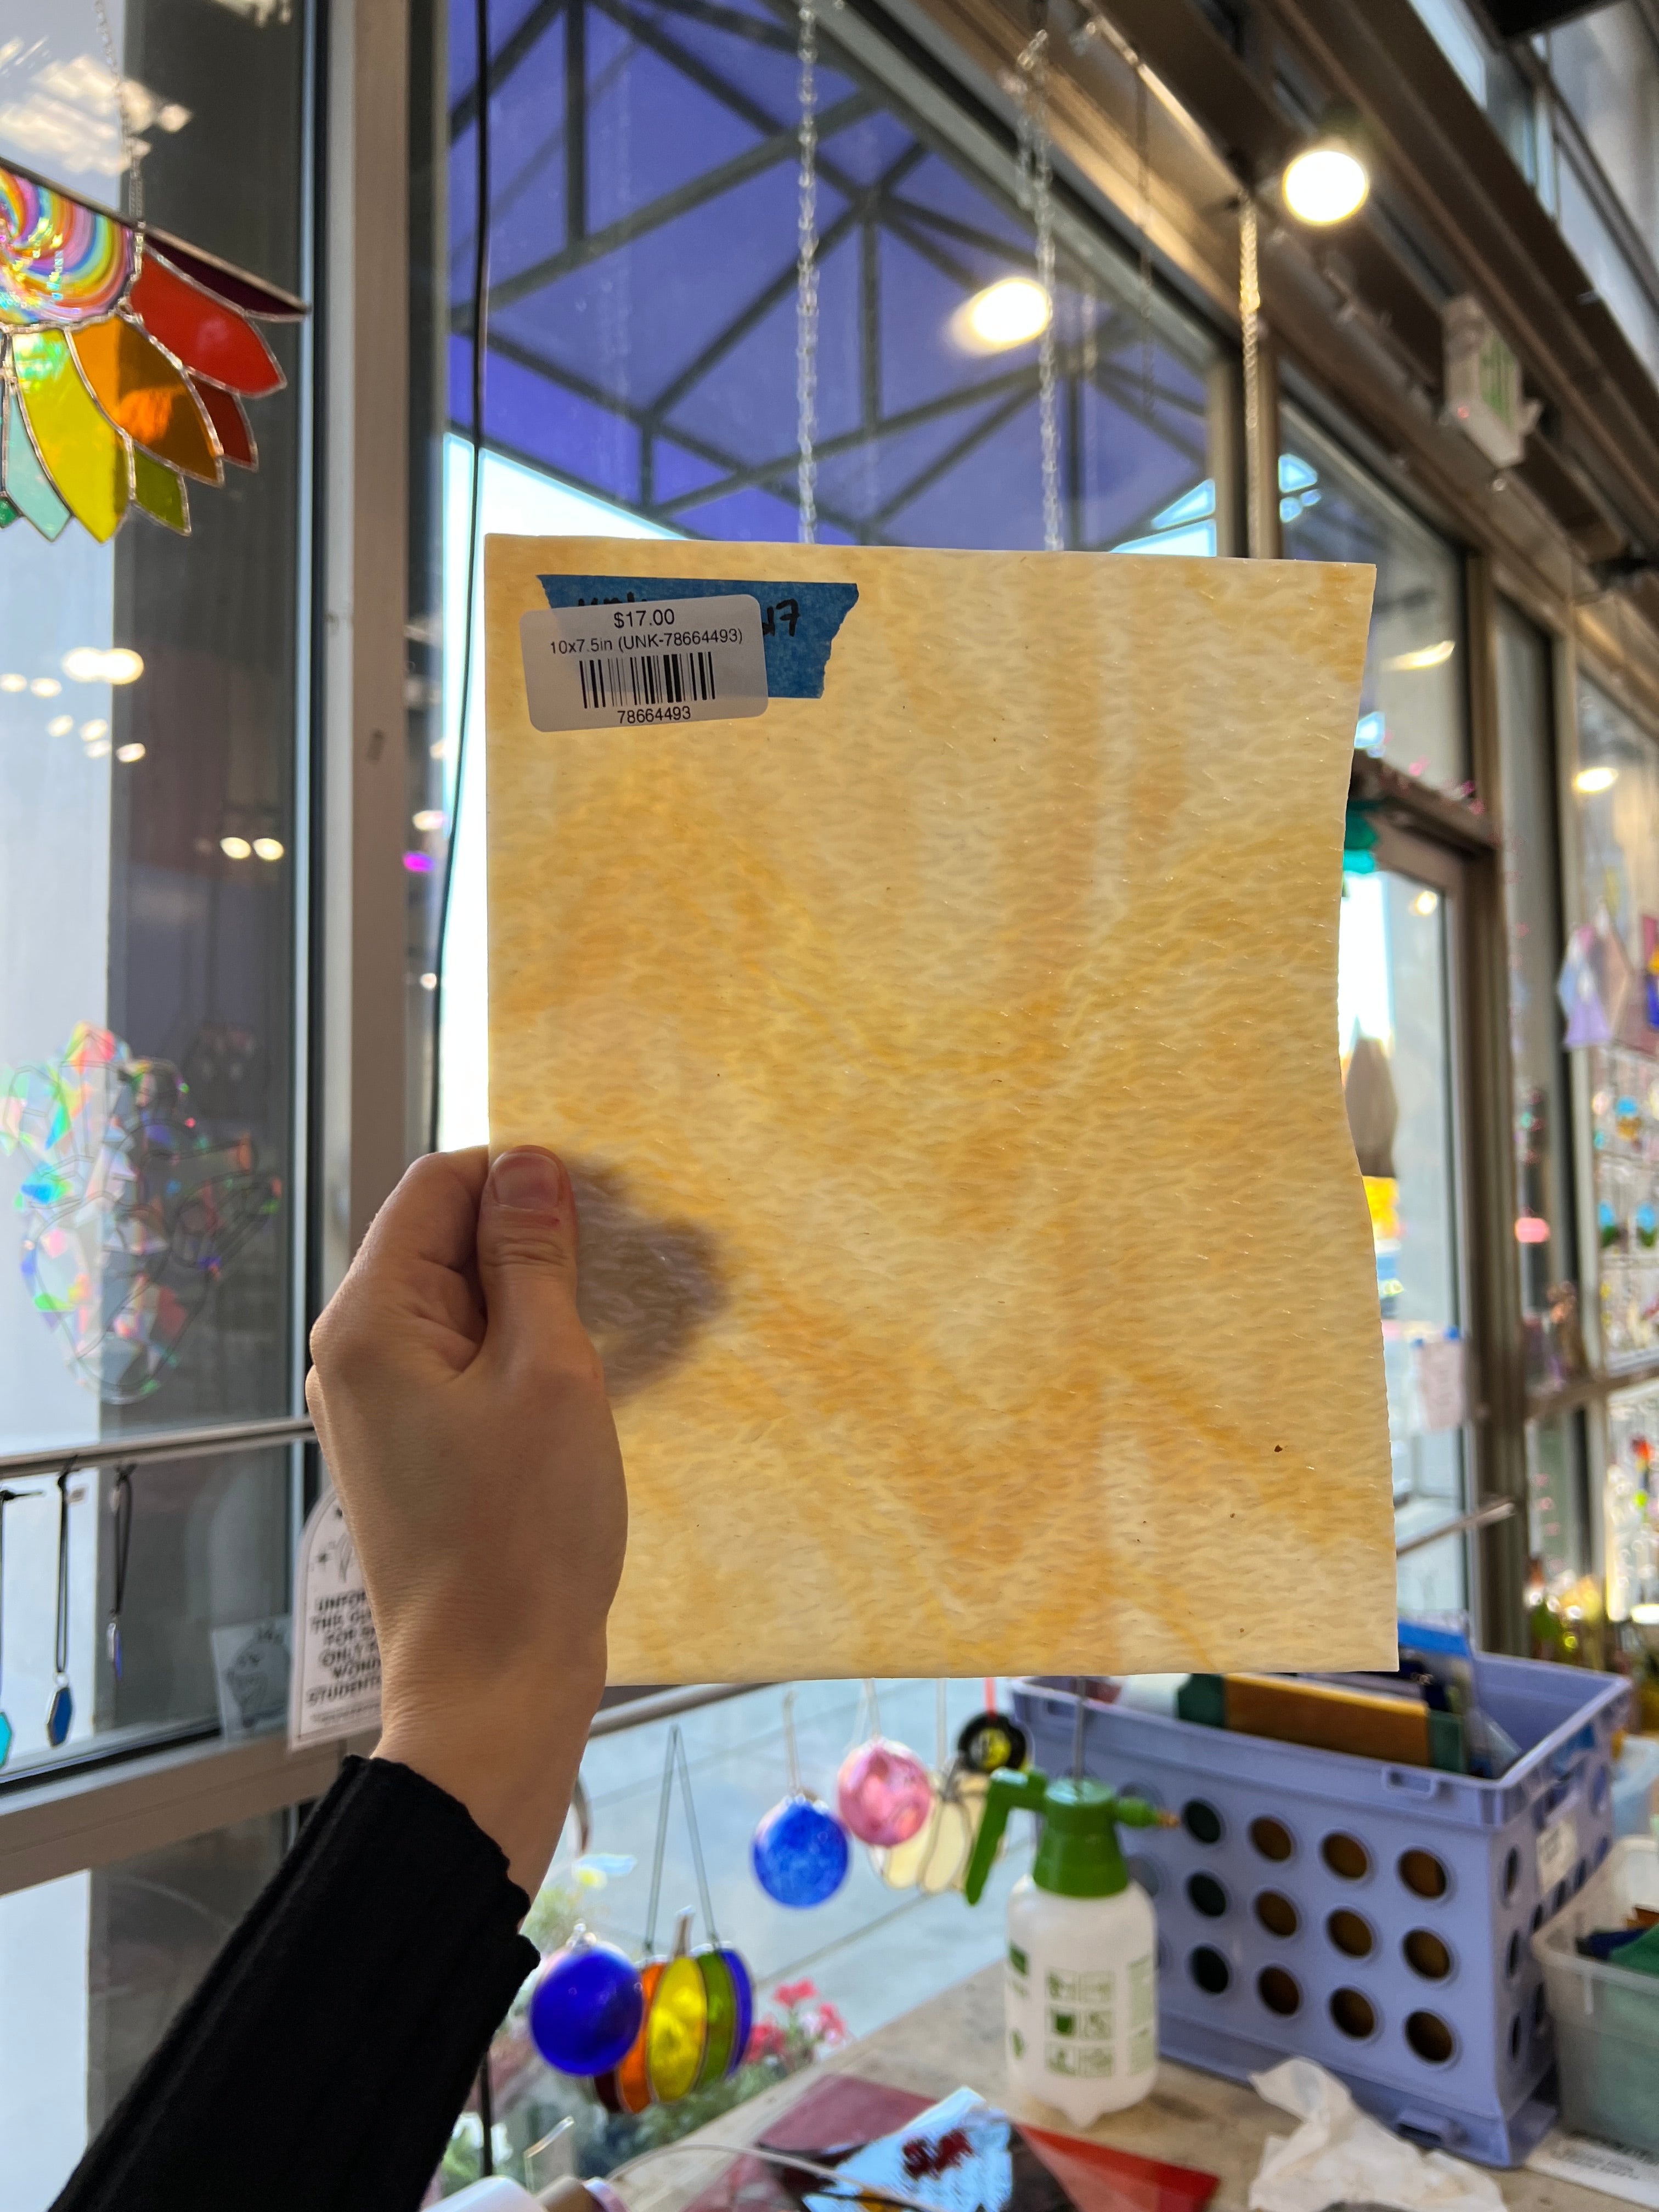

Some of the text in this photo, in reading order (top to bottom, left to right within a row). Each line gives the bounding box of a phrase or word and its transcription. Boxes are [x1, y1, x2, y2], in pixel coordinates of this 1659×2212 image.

[613, 608, 675, 629] $17.00
[550, 628, 743, 655] 10x7.5in (UNK-78664493)
[617, 705, 691, 724] 78664493
